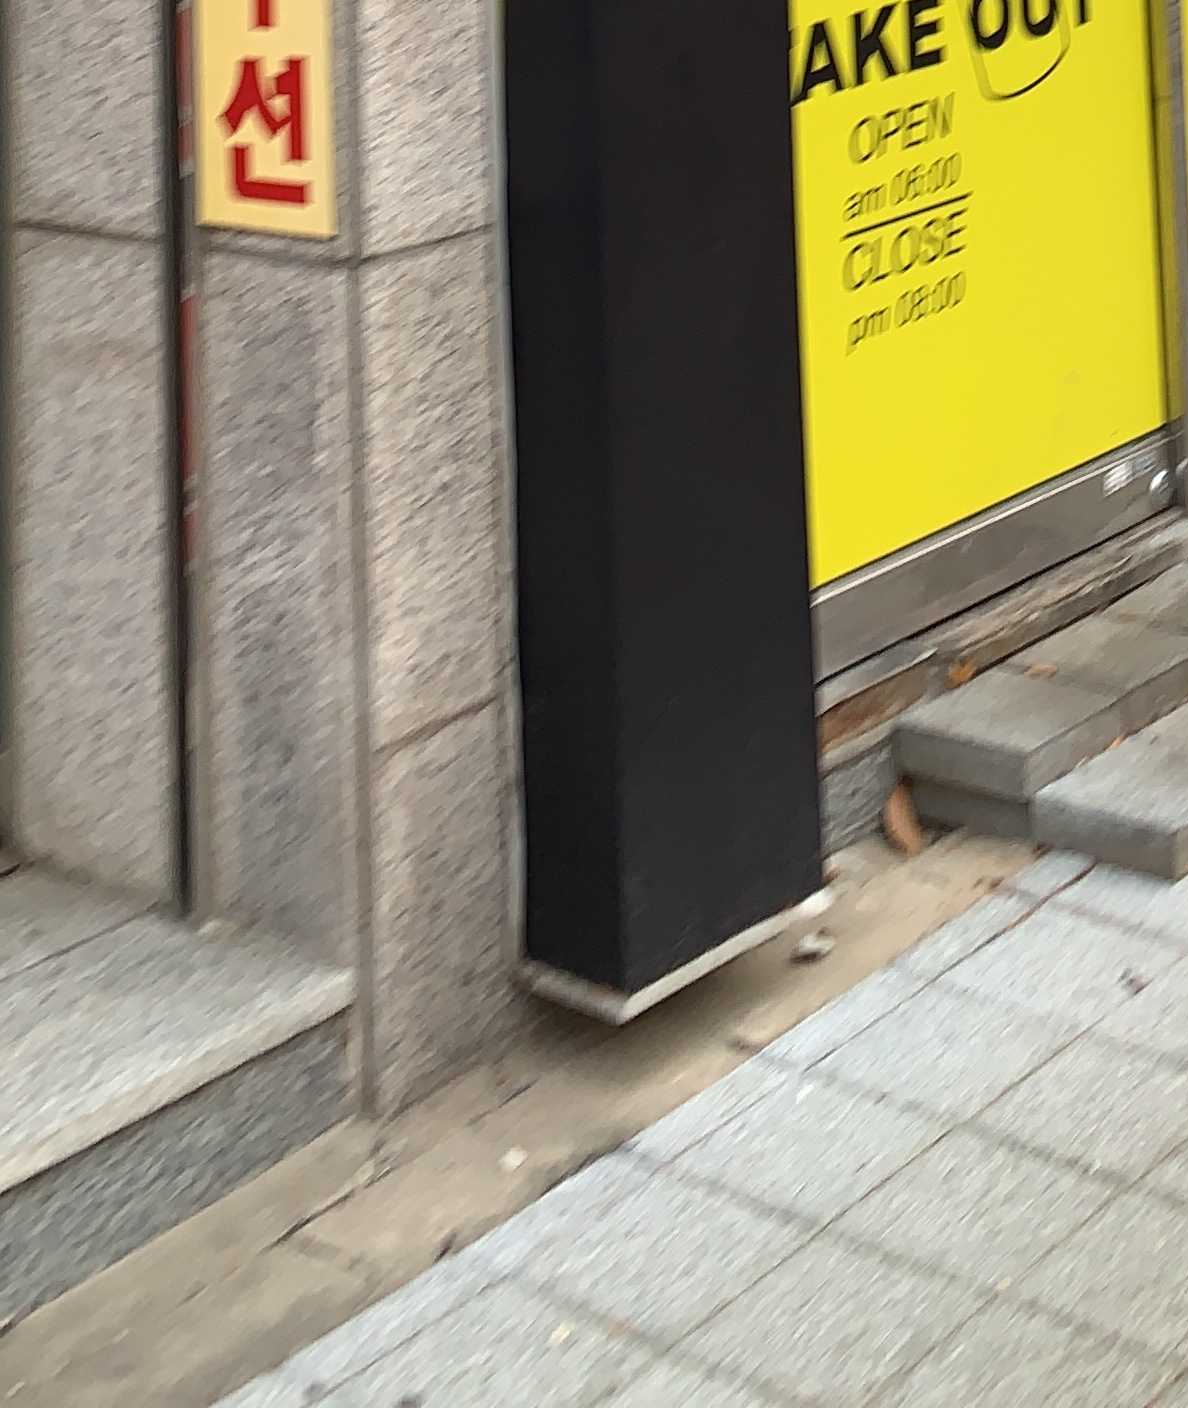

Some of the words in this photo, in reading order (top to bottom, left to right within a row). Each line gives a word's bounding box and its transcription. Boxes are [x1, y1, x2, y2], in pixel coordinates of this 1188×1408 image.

[847, 92, 957, 166] OPEN
[842, 187, 887, 222] am
[841, 207, 970, 293] CLOSE
[843, 304, 891, 358] pm
